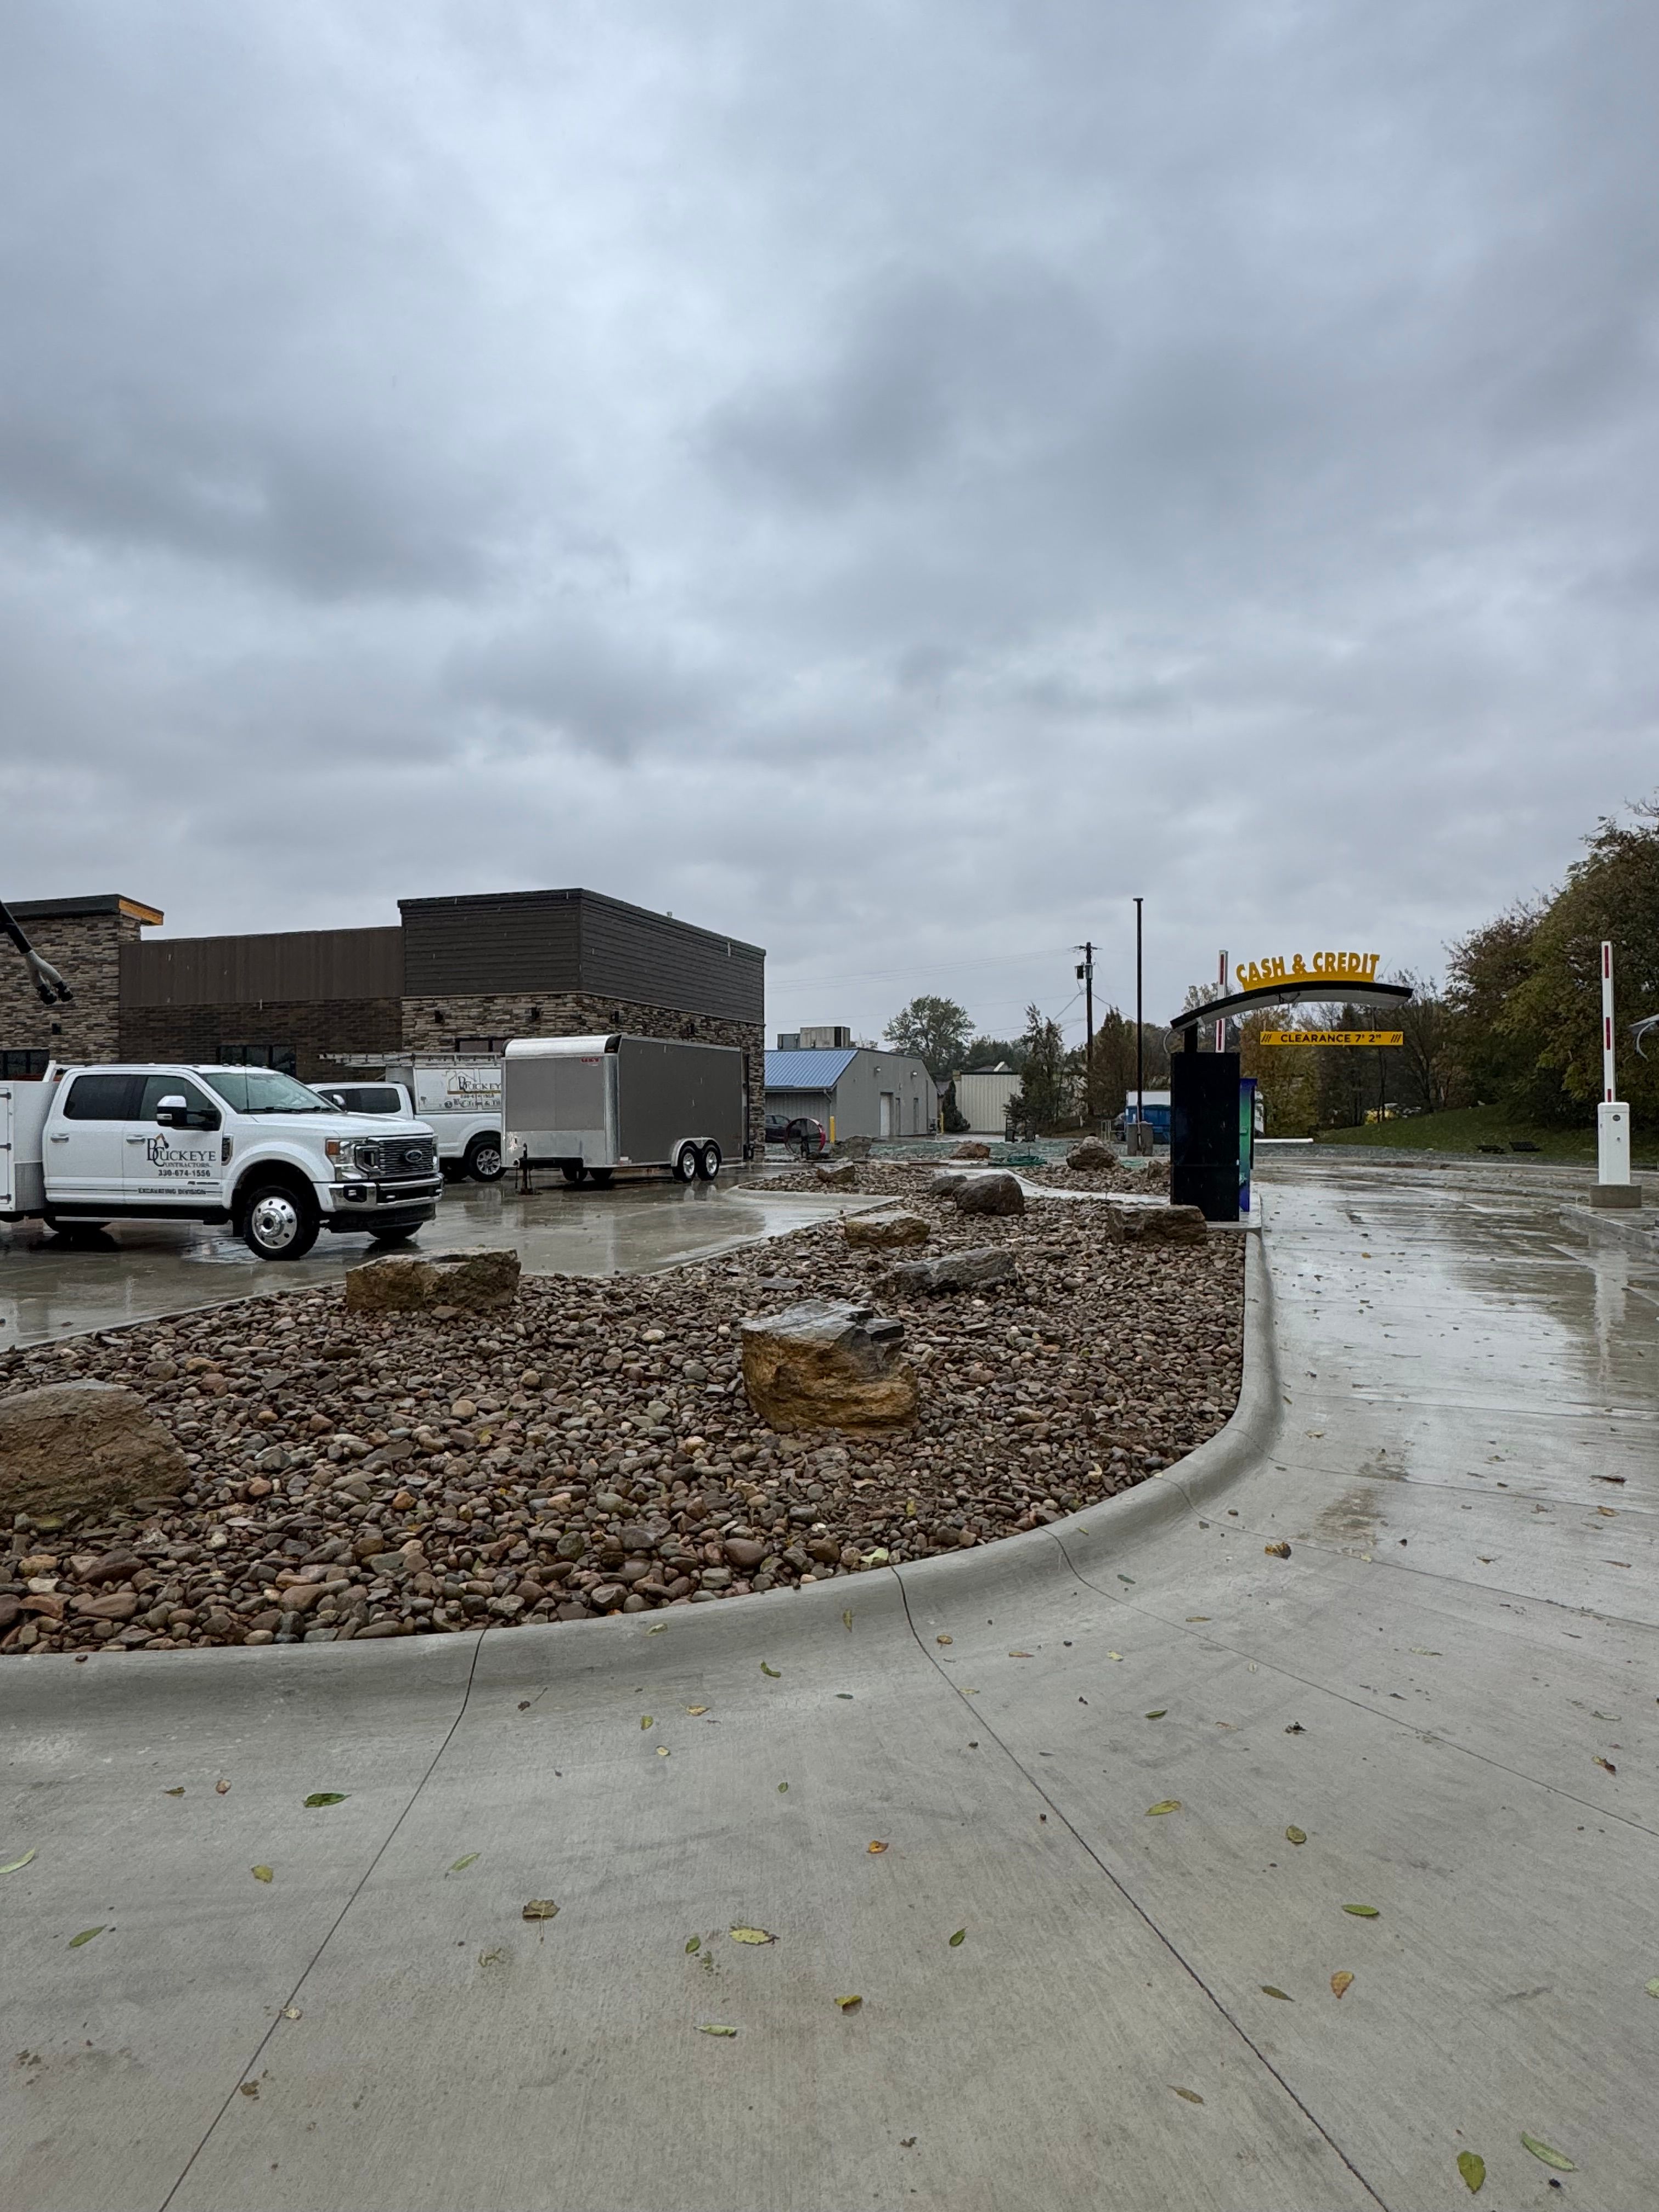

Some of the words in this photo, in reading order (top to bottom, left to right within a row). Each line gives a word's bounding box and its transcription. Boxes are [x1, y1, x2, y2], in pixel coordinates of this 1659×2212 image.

[1236, 956, 1285, 983] CASH
[1292, 953, 1307, 974] &
[1312, 952, 1380, 974] CREDIT
[1280, 1034, 1351, 1043] CLEARANCE
[1355, 1034, 1365, 1043] 7'
[458, 1076, 501, 1091] BUCKEY
[146, 1138, 216, 1161] BUCKEYE
